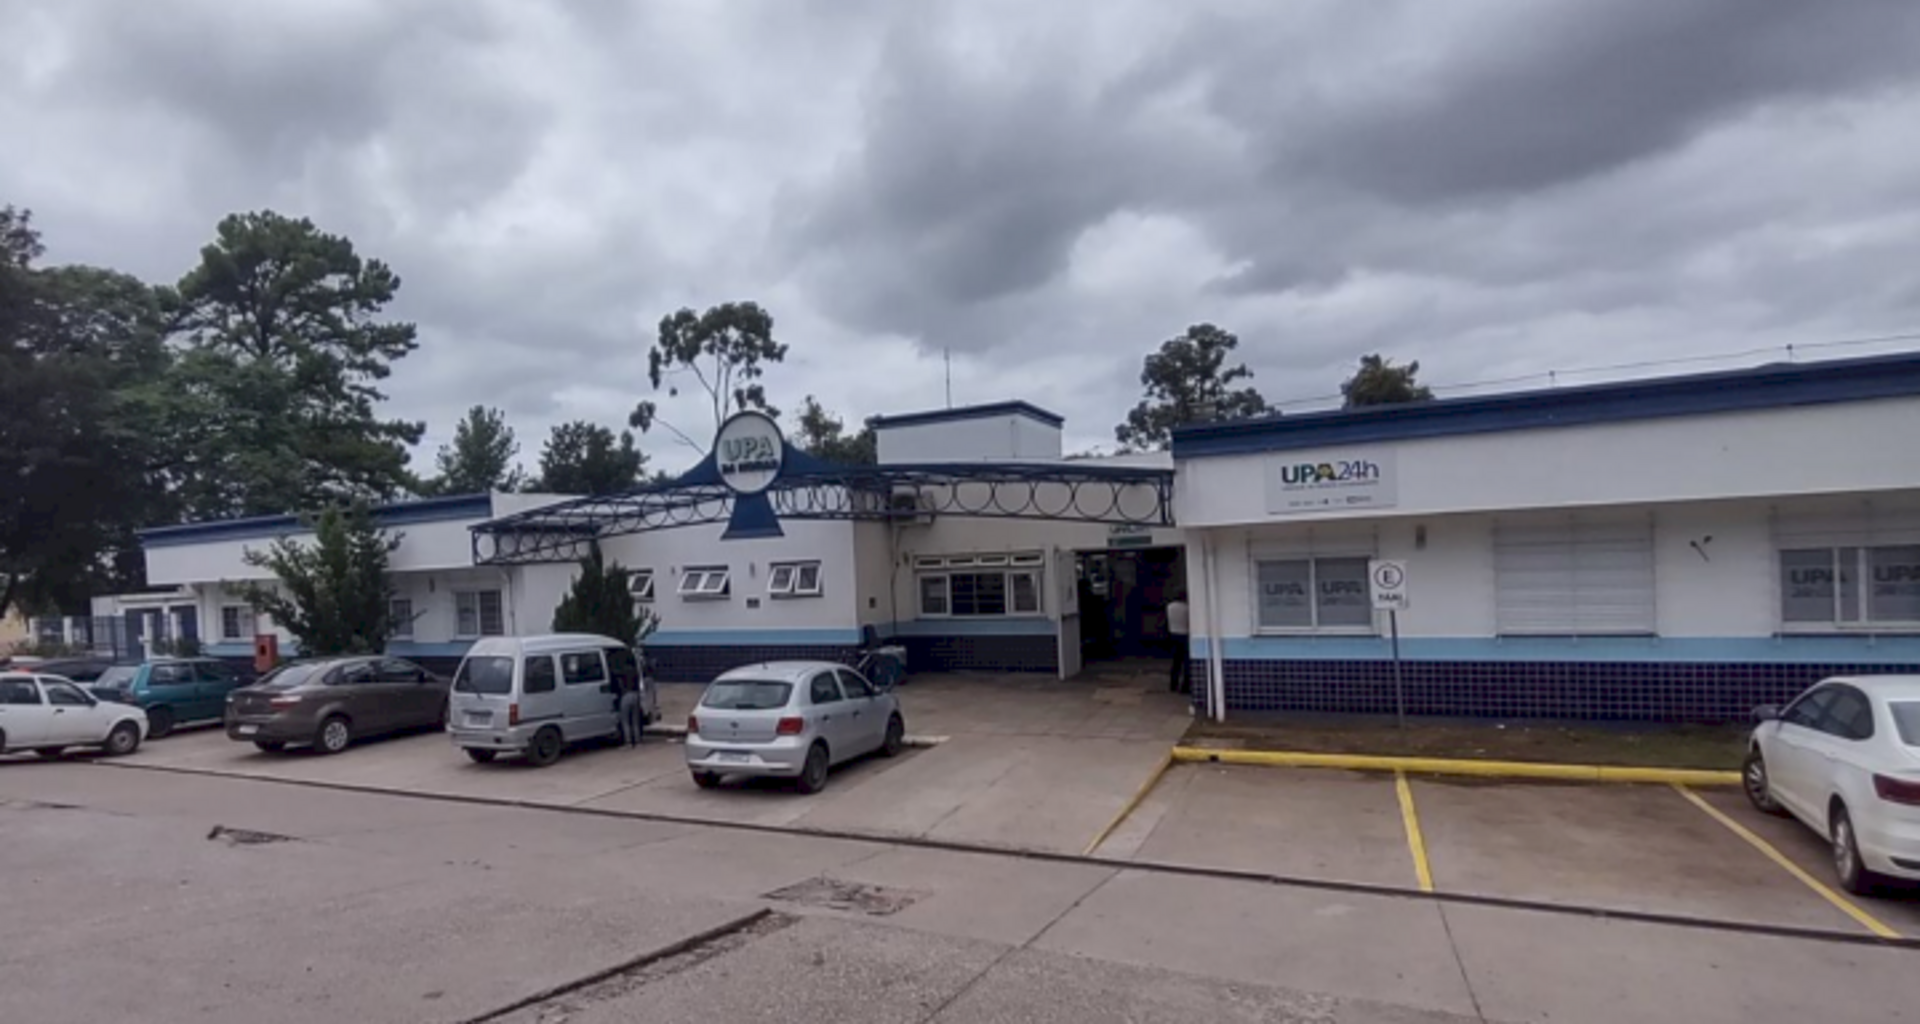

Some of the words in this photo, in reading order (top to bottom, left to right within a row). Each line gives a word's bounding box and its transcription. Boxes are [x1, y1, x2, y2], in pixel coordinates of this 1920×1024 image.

[722, 435, 774, 461] UPA
[1383, 570, 1396, 585] E
[1790, 568, 1847, 585] UPA
[1266, 582, 1304, 595] UPA
[1322, 580, 1362, 594] UPA
